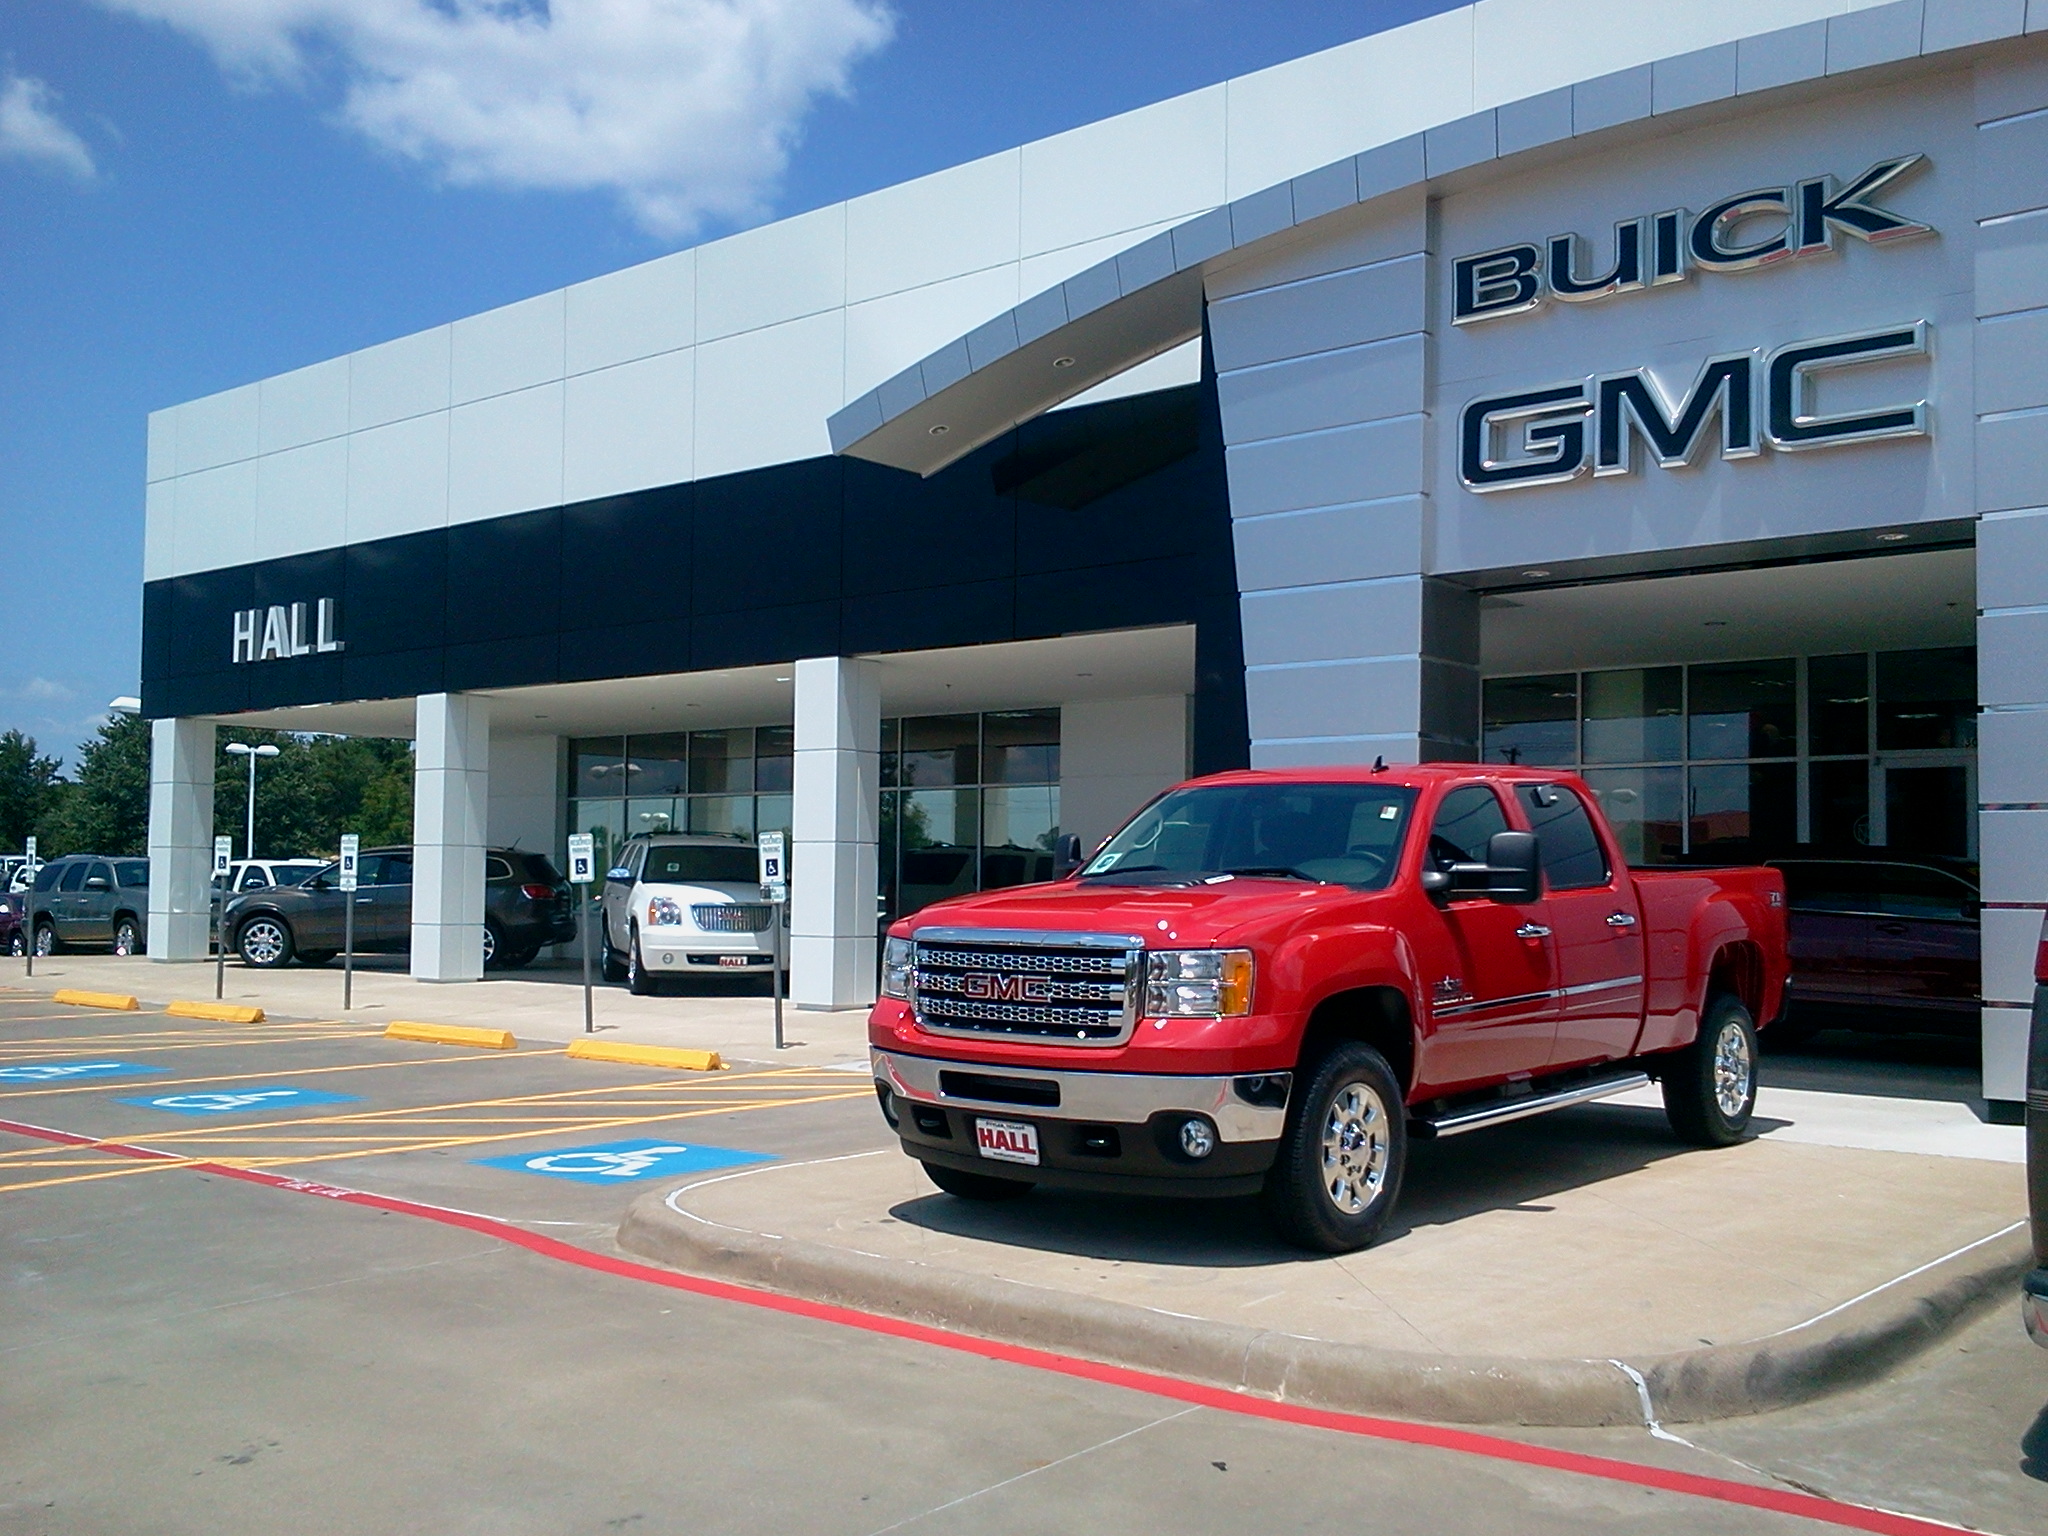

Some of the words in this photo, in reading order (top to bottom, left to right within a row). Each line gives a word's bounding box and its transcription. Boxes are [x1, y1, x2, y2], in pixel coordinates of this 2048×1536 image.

[1450, 152, 1938, 327] BUICK
[1457, 319, 1933, 494] GMC
[233, 597, 345, 664] HALL
[720, 957, 747, 967] HALL
[964, 972, 1052, 1003] GMC
[978, 1127, 1037, 1155] HALL
